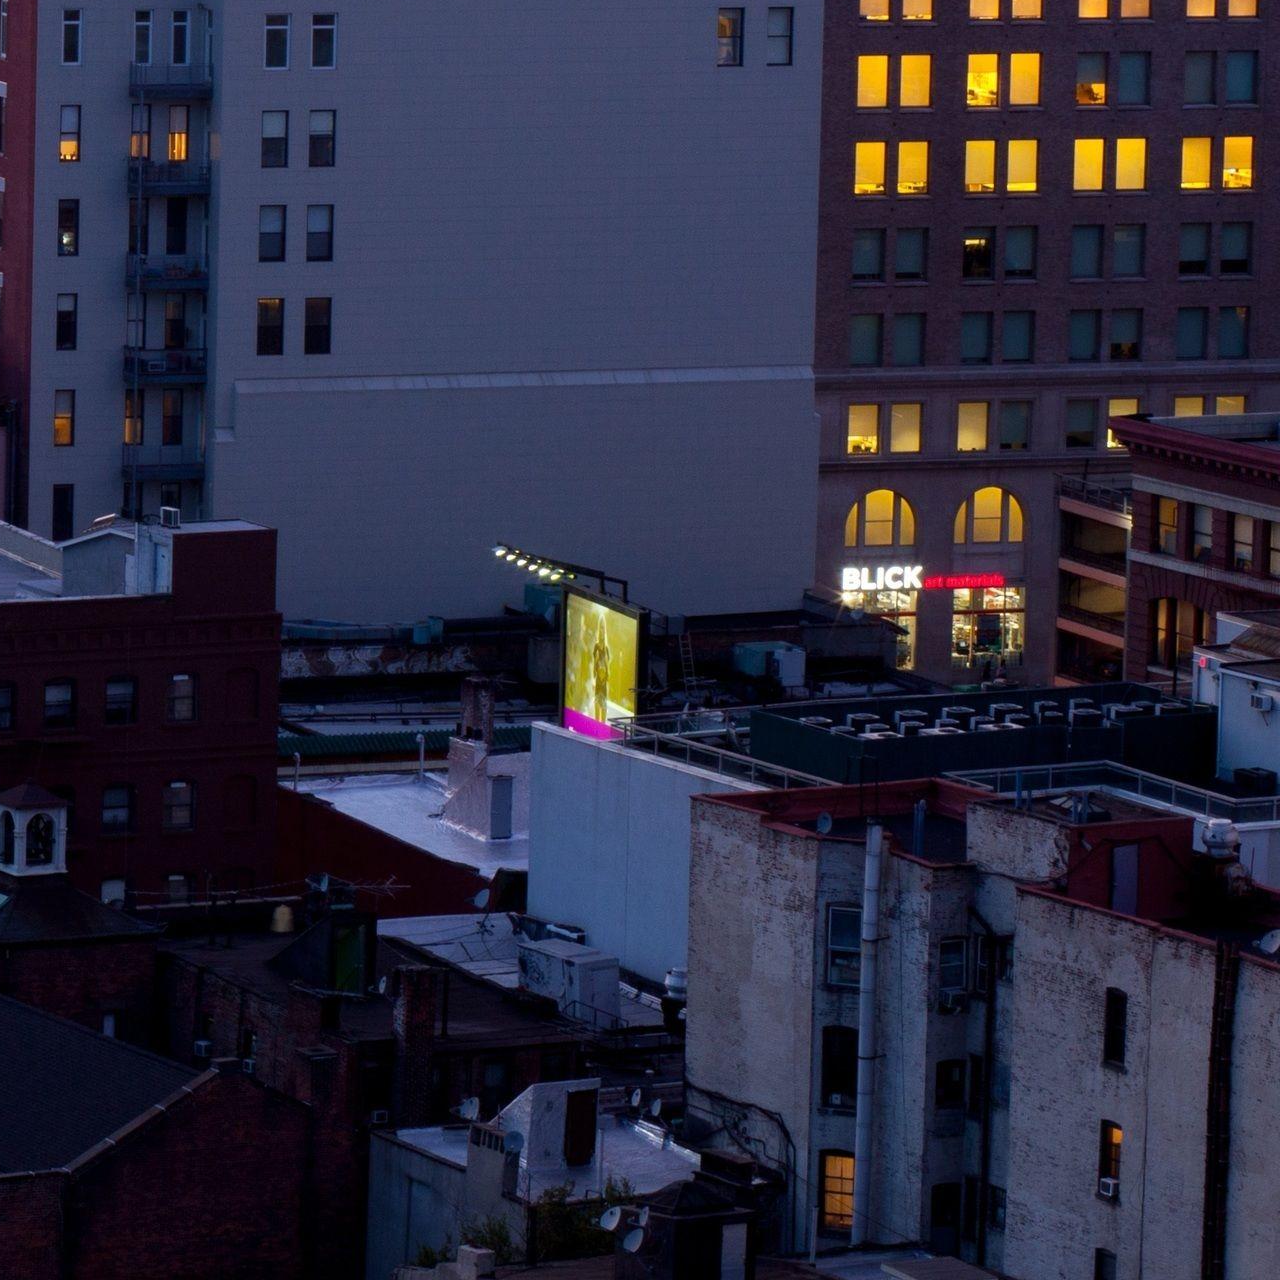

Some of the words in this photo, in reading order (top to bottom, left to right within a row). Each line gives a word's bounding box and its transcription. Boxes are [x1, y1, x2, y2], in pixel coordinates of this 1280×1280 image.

[842, 565, 923, 590] BLICK
[924, 577, 944, 588] art
[945, 573, 1006, 588] materials
